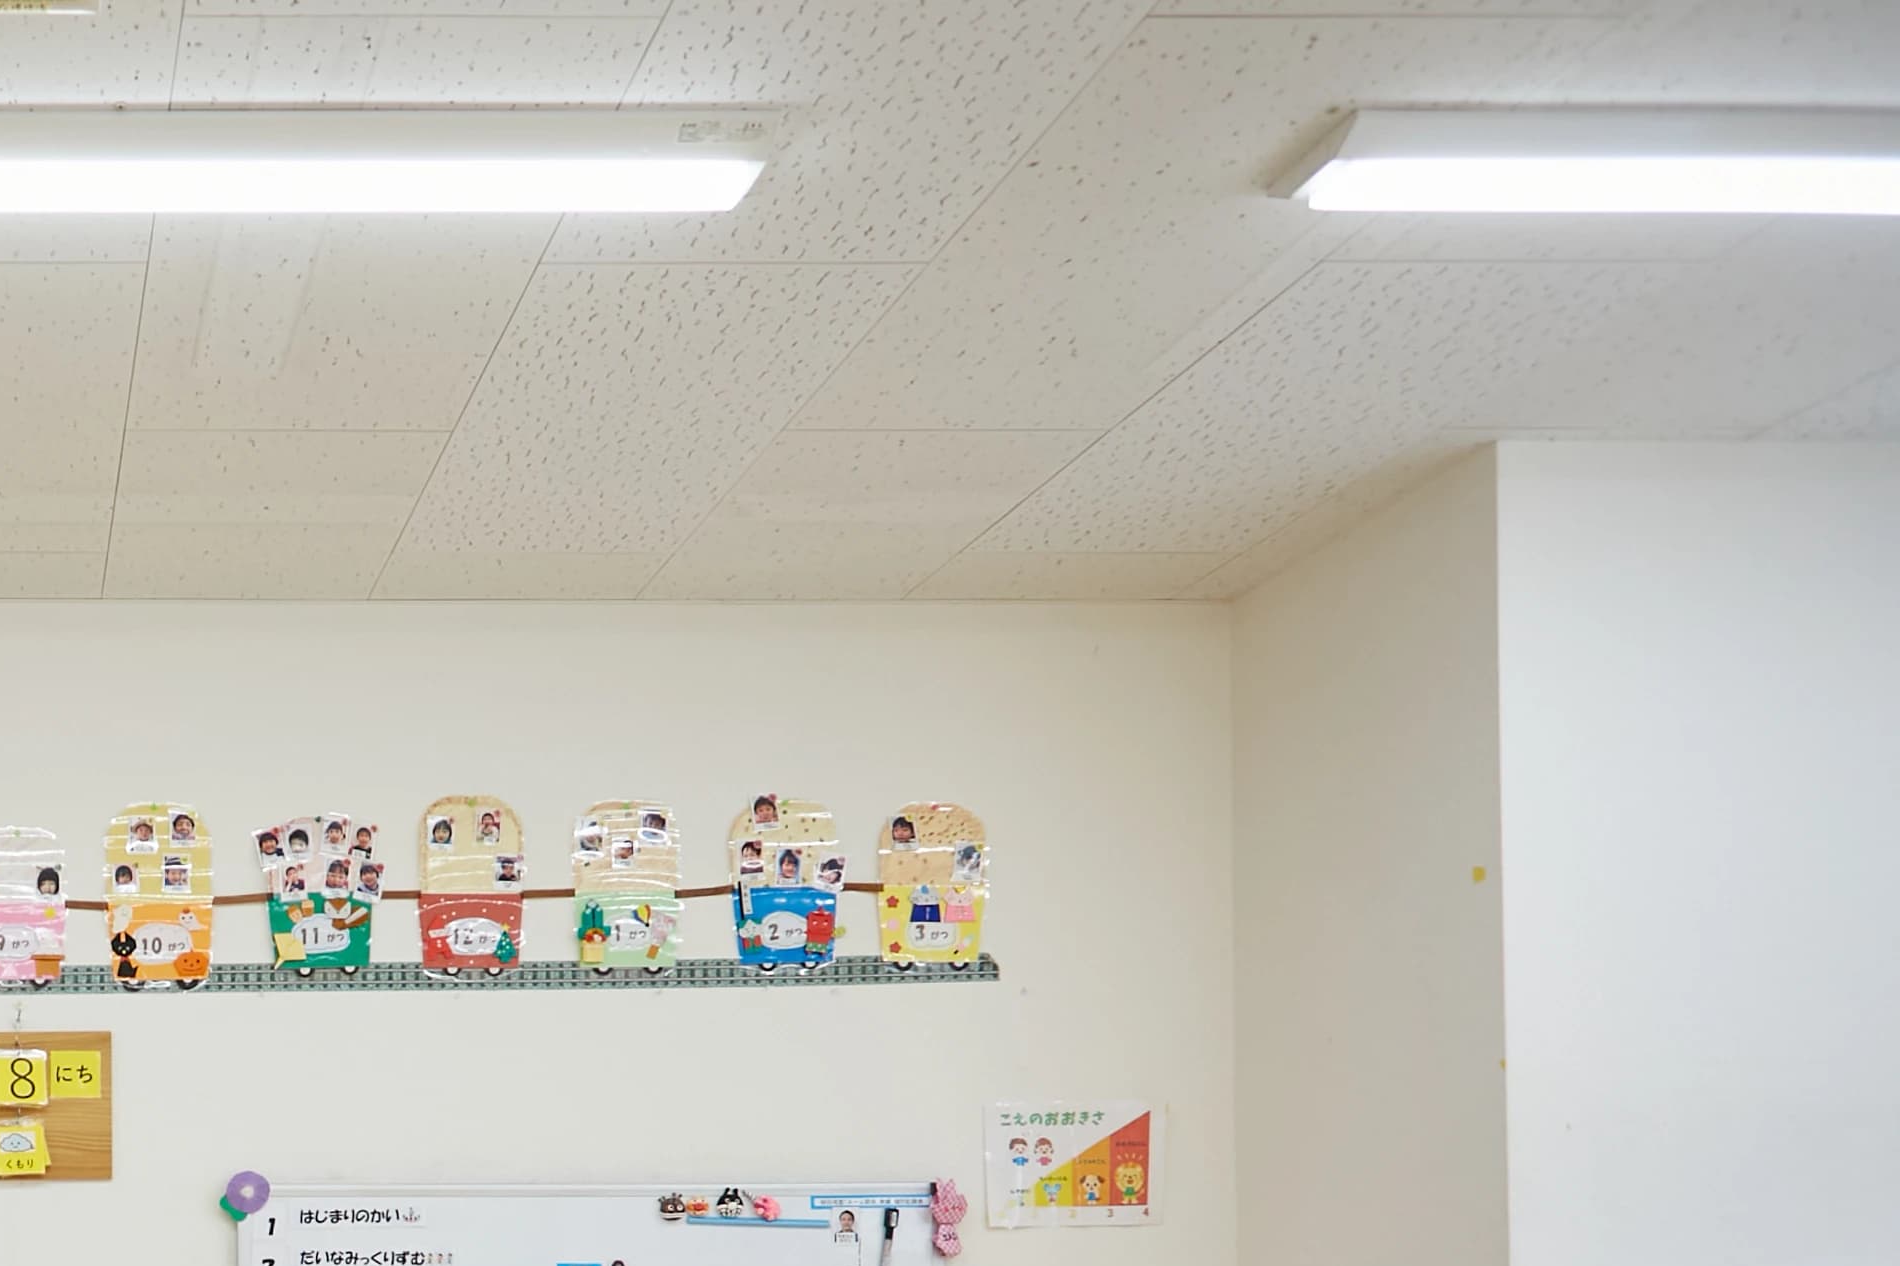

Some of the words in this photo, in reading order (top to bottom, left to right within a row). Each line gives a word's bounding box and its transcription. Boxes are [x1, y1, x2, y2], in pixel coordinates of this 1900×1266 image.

[301, 928, 318, 945] 11
[327, 933, 345, 943] がつ
[615, 924, 621, 941] 1
[629, 930, 647, 940] がつ
[768, 923, 779, 940] 2
[915, 924, 925, 941] 3
[931, 930, 949, 940] がつ
[142, 937, 162, 955] 10
[168, 942, 186, 952] がつ
[10, 1057, 36, 1100] 8
[55, 1064, 94, 1084] にち
[1000, 1110, 1106, 1127] こえのおおきさ
[5, 1159, 34, 1170] くもり
[267, 1217, 277, 1236] 1
[299, 1208, 401, 1225] はじまりのかい
[299, 1249, 426, 1266] だいなみっくりずむ
